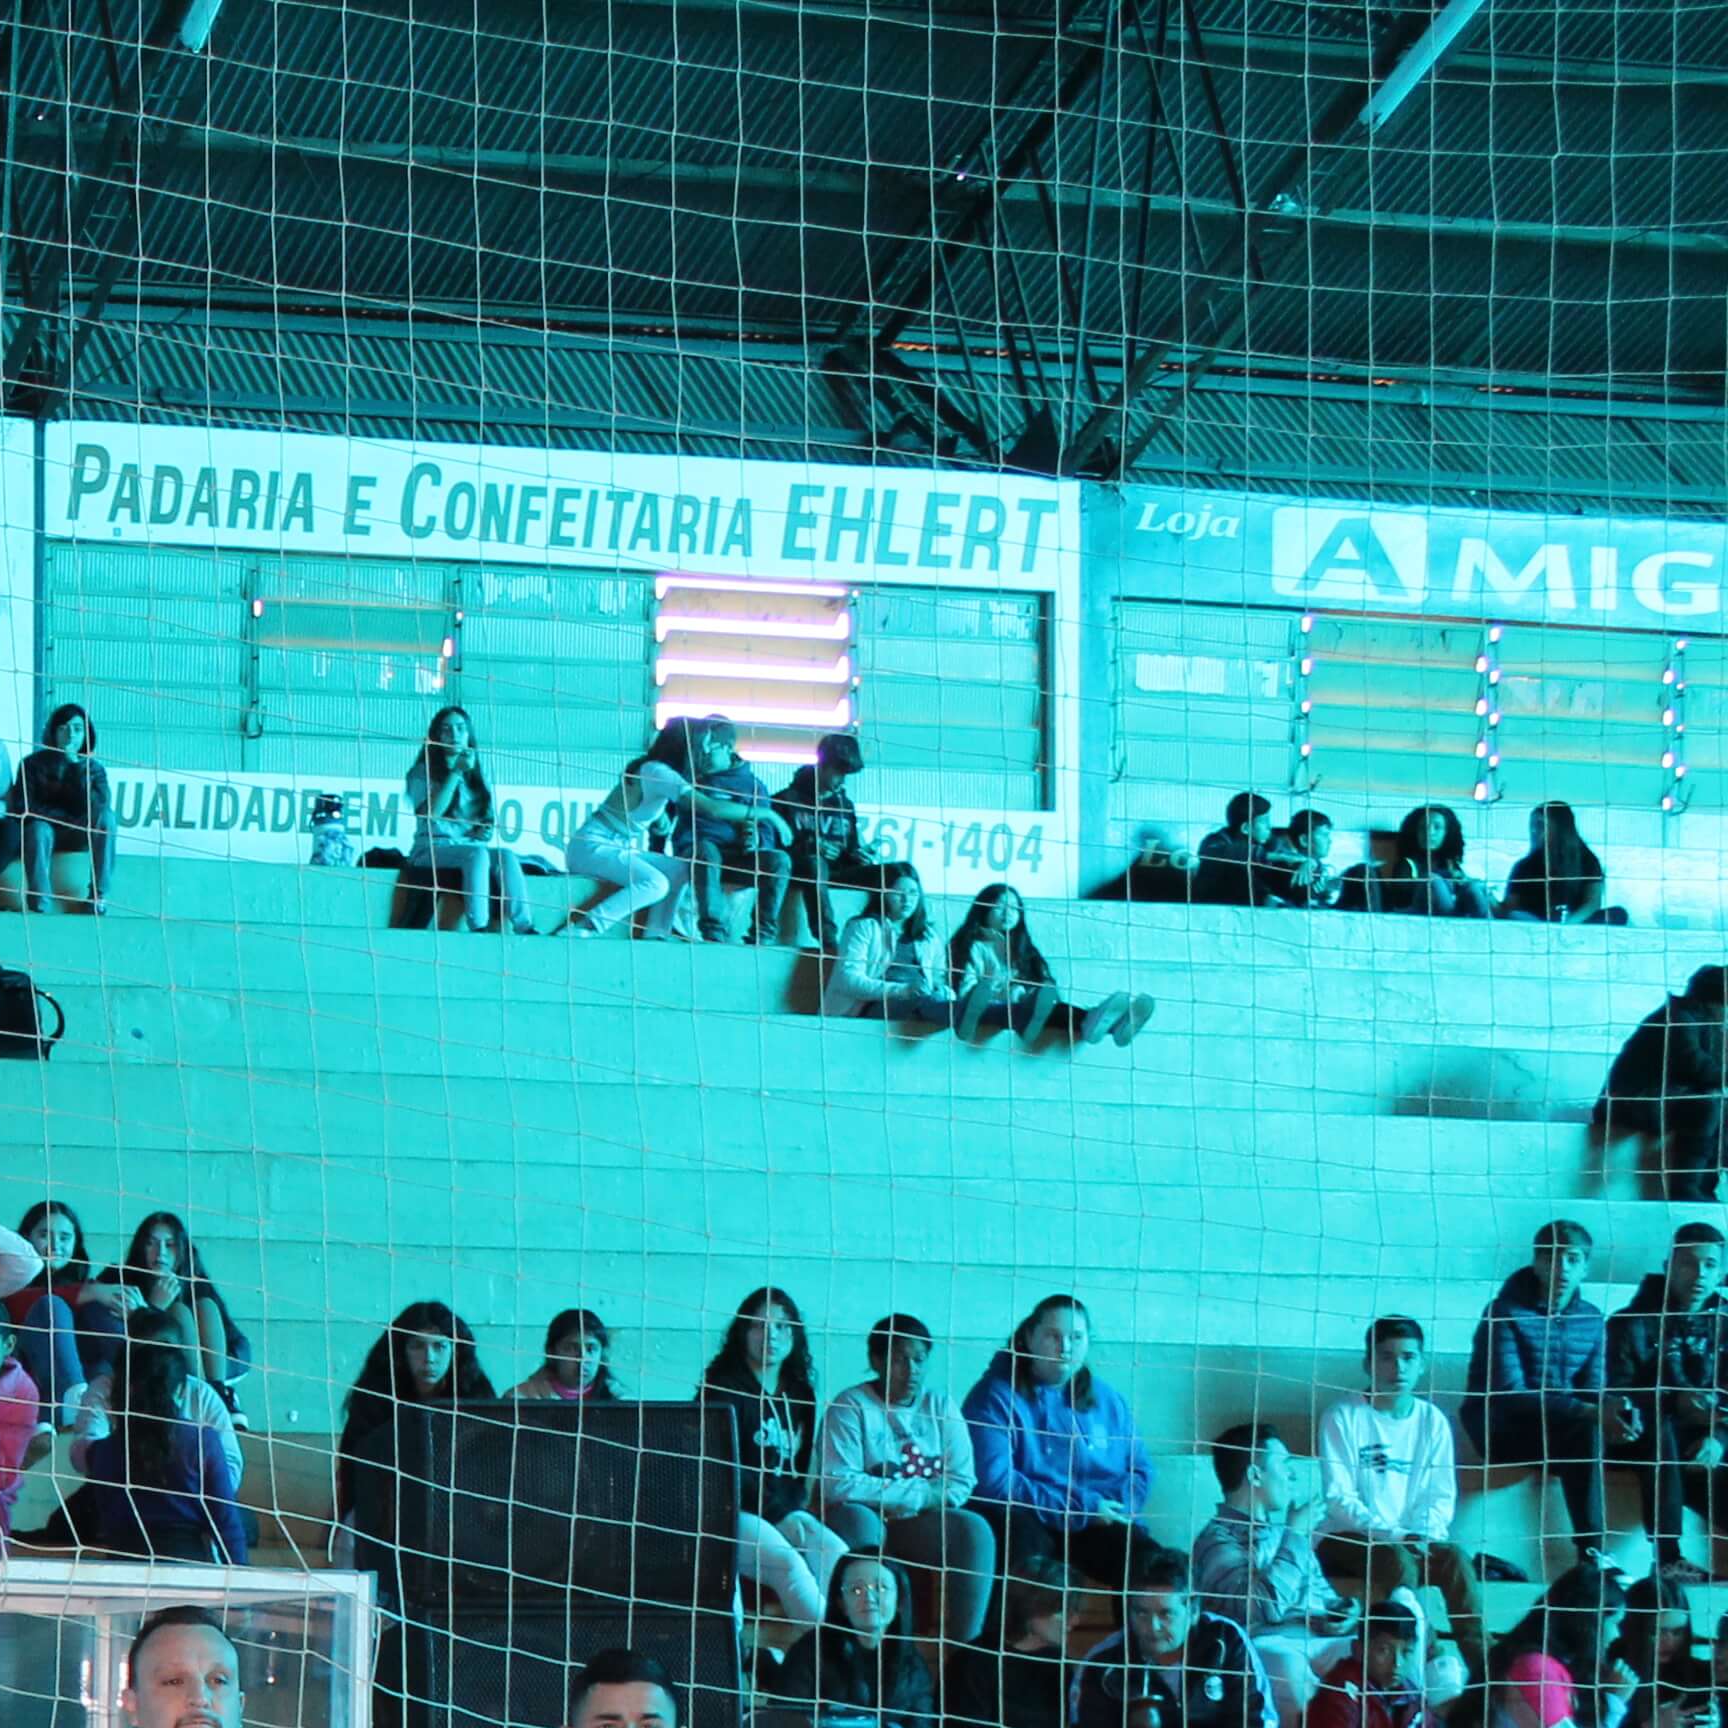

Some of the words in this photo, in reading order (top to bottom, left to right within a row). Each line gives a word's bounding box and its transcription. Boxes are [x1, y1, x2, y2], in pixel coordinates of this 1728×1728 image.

[66, 443, 315, 533] PADARIA
[343, 475, 378, 535] E
[400, 462, 753, 558] CONFEITARIA
[780, 482, 1060, 574] EHLERT
[1135, 501, 1241, 541] Loja
[115, 780, 318, 836] UALIDADE
[341, 790, 399, 837] EM
[855, 811, 1045, 874] 61-1404
